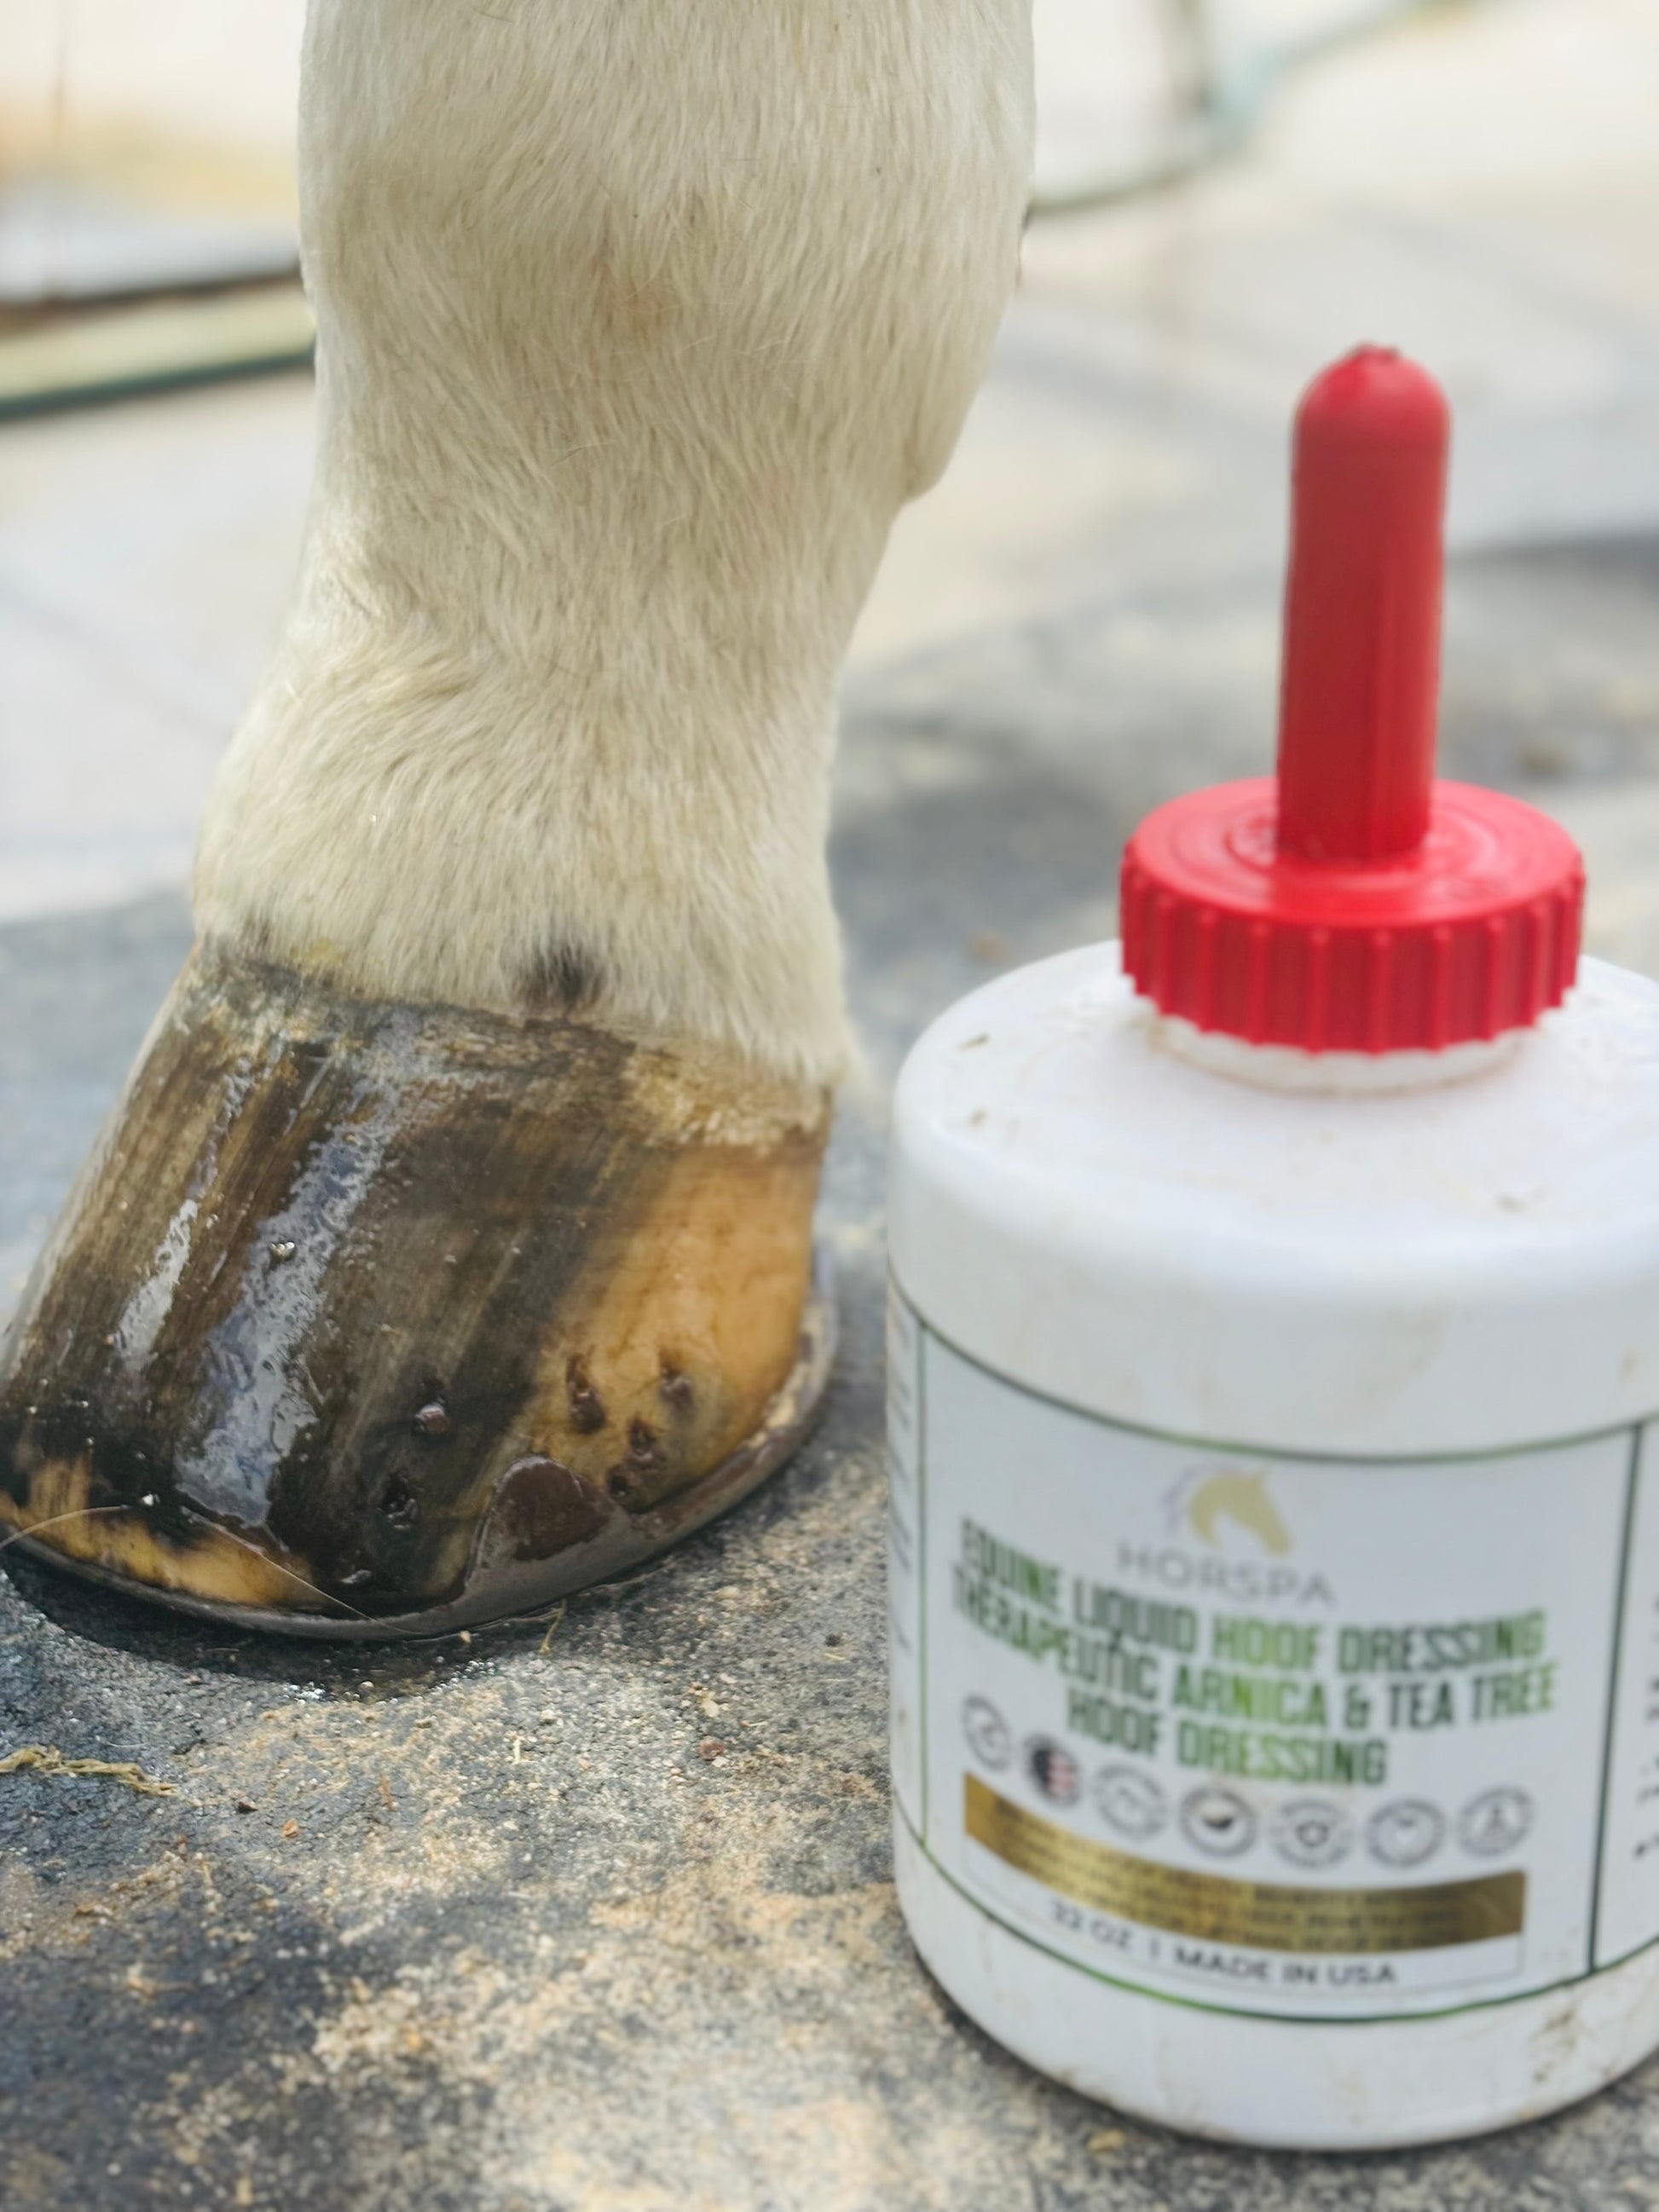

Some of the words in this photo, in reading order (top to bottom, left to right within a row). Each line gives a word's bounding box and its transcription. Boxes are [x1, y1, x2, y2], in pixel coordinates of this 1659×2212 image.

[962, 1516, 1060, 1615] EQUINE
[1073, 1577, 1198, 1655] LIQUID
[1213, 1615, 1319, 1671] HOOF
[1337, 1608, 1547, 1674] DRESSING
[1117, 1539, 1336, 1606] HORSPA
[952, 1558, 1158, 1704] THERAPEUTIC
[1172, 1664, 1327, 1727] ARNICA
[1344, 1683, 1369, 1730] &
[1388, 1681, 1455, 1730] TEA
[1472, 1660, 1558, 1724] TREE
[1068, 1688, 1160, 1759] HOOF
[1177, 1718, 1386, 1786] DRESSING
[1091, 1918, 1130, 1949] OZ
[1175, 1945, 1269, 1981] MADE
[1284, 1964, 1316, 1984] IN
[1327, 1963, 1396, 1986] USA
